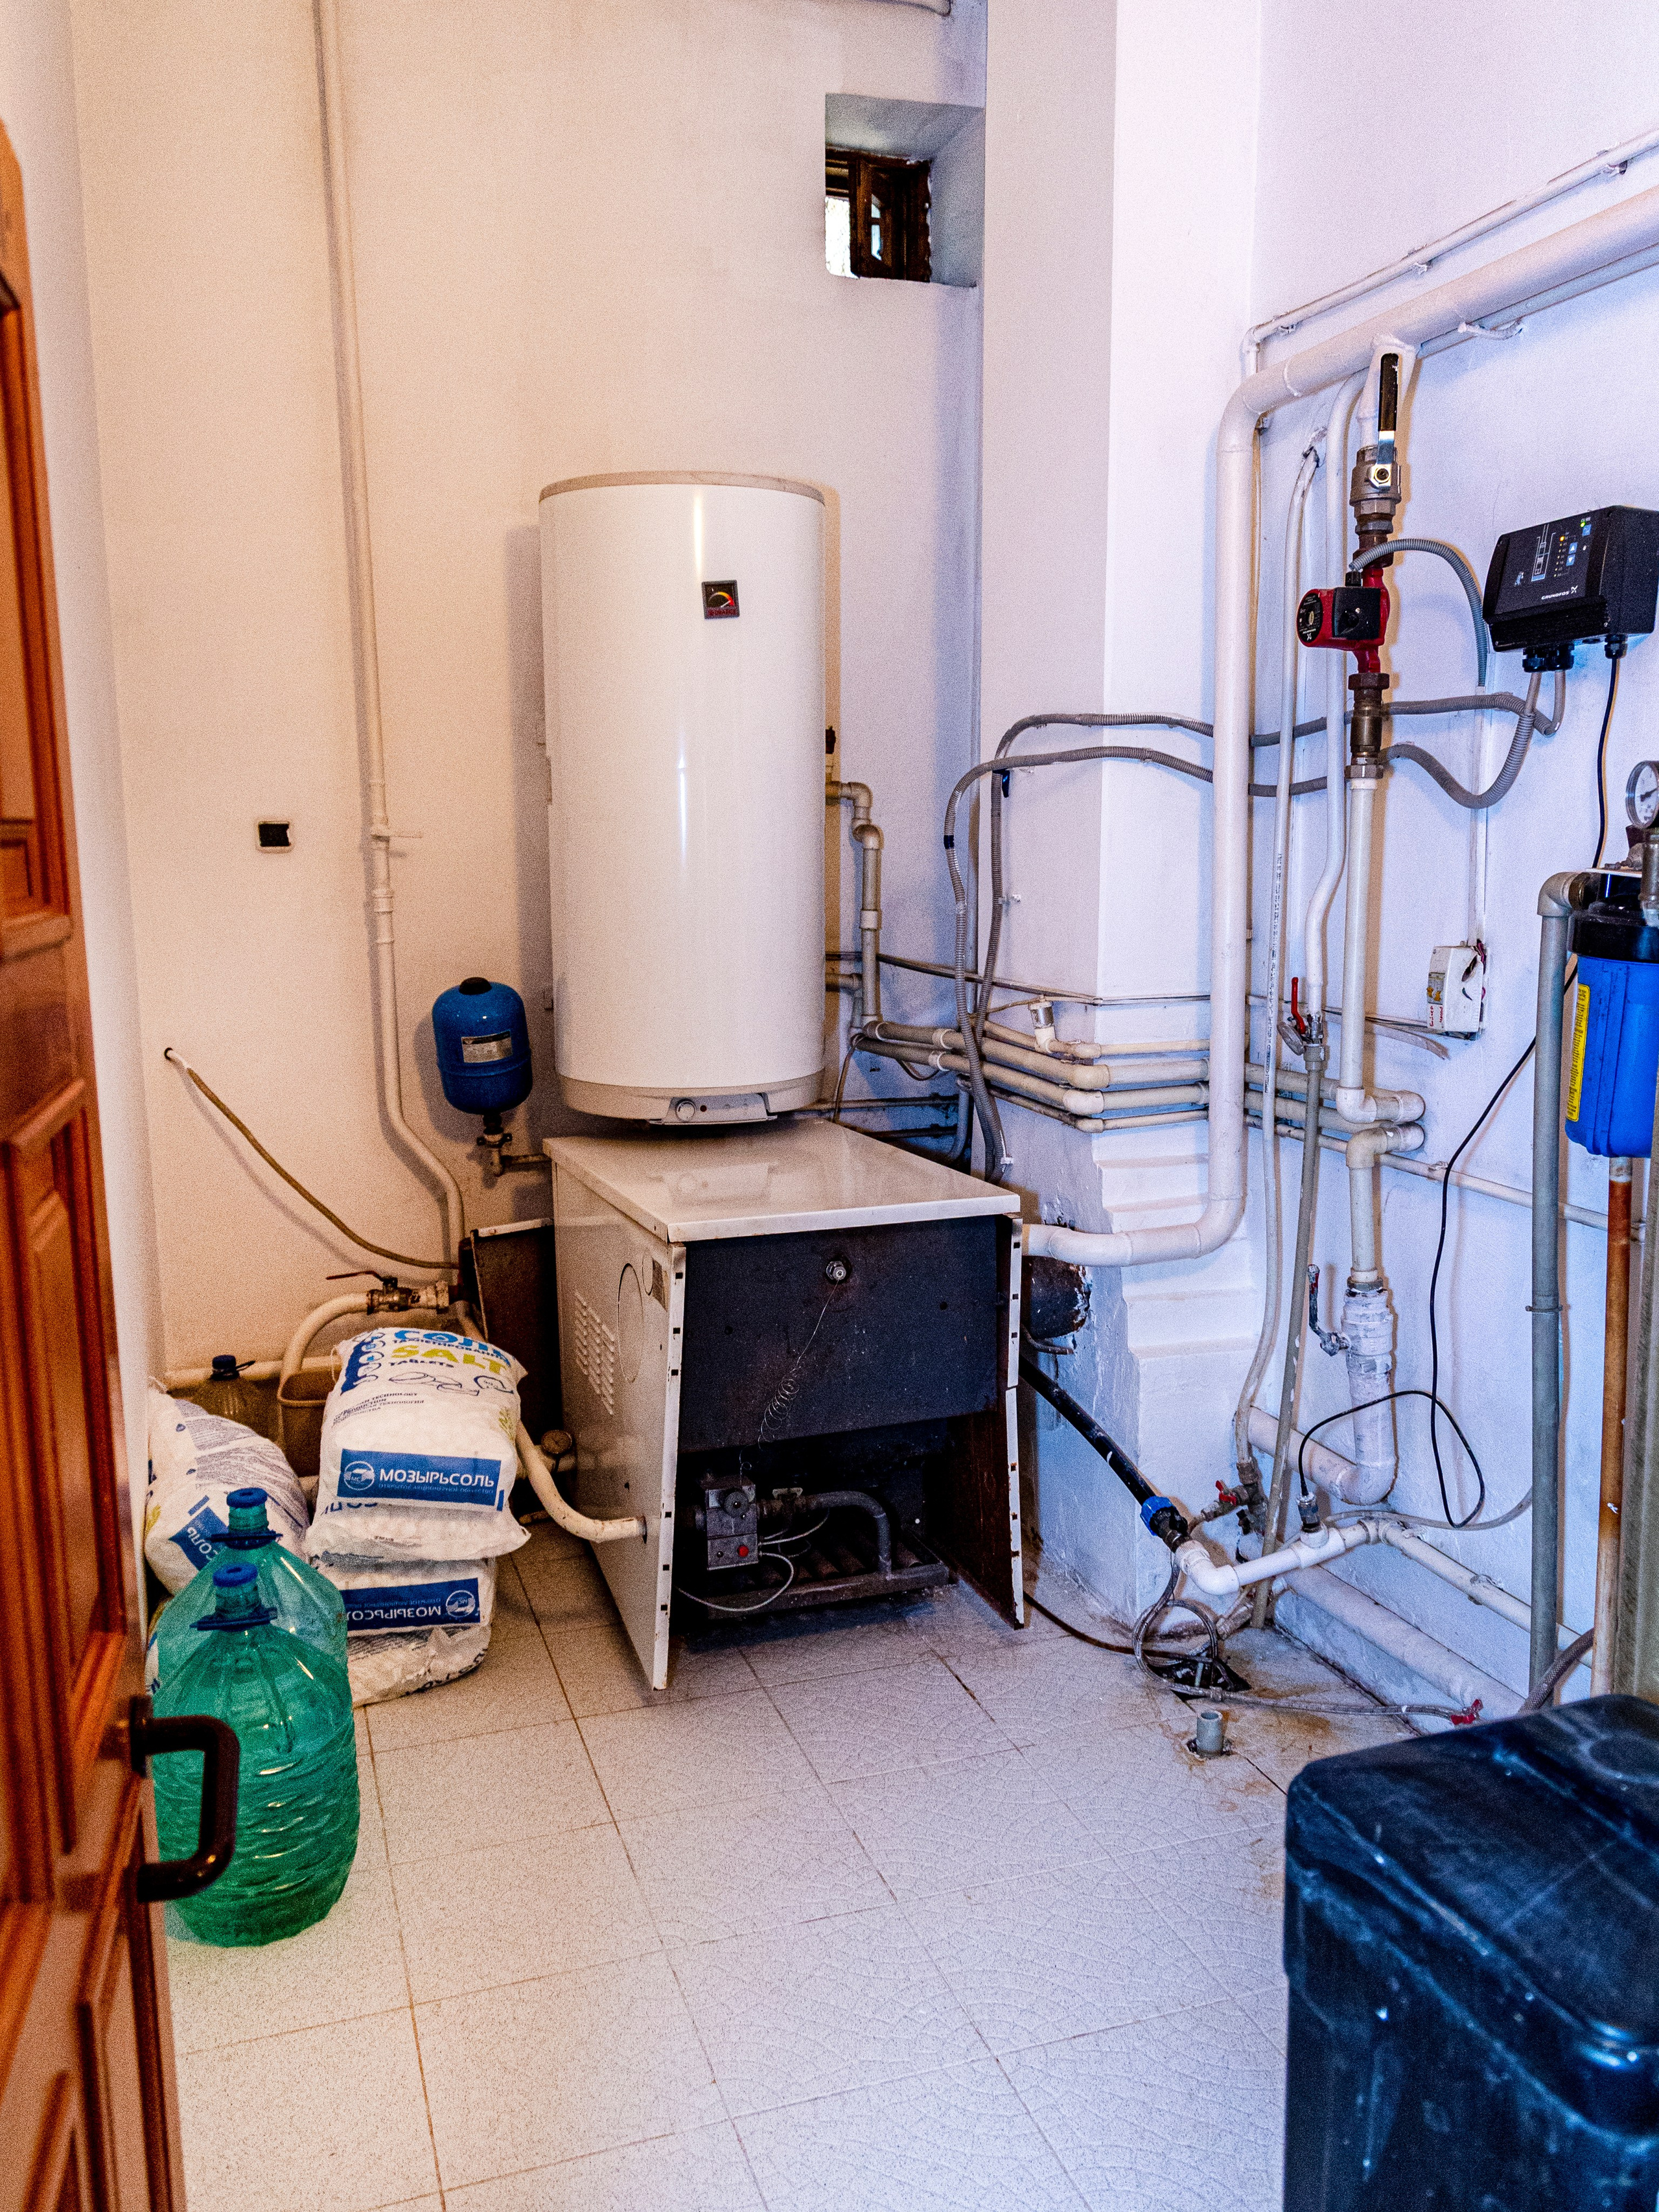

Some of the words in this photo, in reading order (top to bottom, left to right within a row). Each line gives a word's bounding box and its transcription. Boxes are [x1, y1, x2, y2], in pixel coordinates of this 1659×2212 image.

[1541, 590, 1570, 600] GRUNDFOS
[395, 1330, 511, 1368] СОЛЬ
[389, 1358, 454, 1368] TABLETS
[391, 1345, 507, 1374] SALT
[379, 1468, 494, 1487] МОЗЫРЬСОЛЬ
